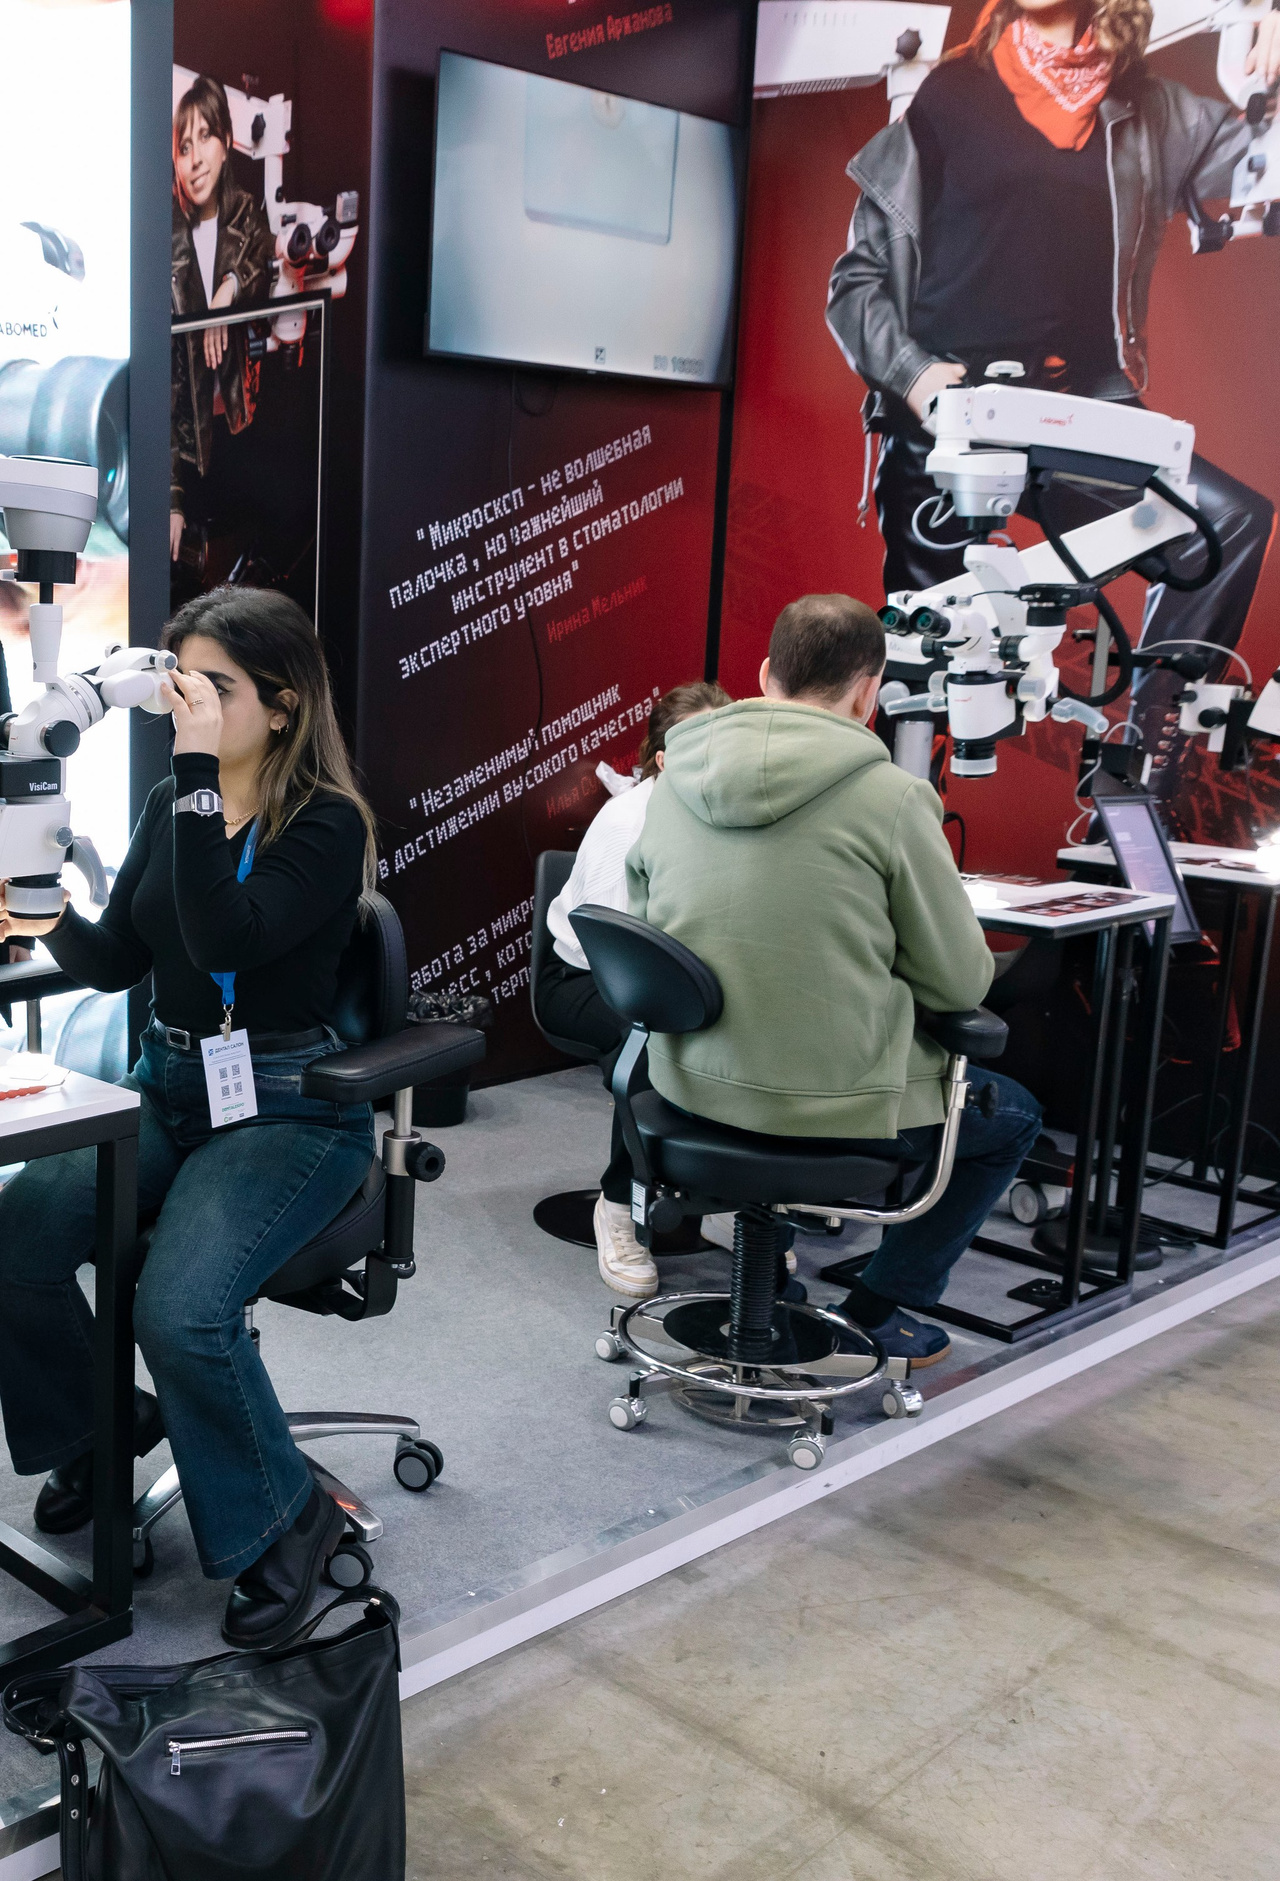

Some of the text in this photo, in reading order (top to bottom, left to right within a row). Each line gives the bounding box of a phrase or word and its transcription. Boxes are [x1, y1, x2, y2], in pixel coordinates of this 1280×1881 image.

[540, 469, 563, 496] не
[564, 424, 652, 485] волшебная
[451, 476, 685, 615] инструмент в стоматологии
[484, 532, 507, 560] но
[398, 602, 511, 680] экспертного
[546, 574, 648, 644] Ирина Мельник
[541, 683, 621, 746] помощник
[29, 781, 58, 792] VisiCam
[377, 857, 390, 880] в
[394, 789, 501, 875] достижении
[502, 742, 579, 804] высокого
[466, 927, 489, 956] за
[490, 964, 532, 1004] терп
